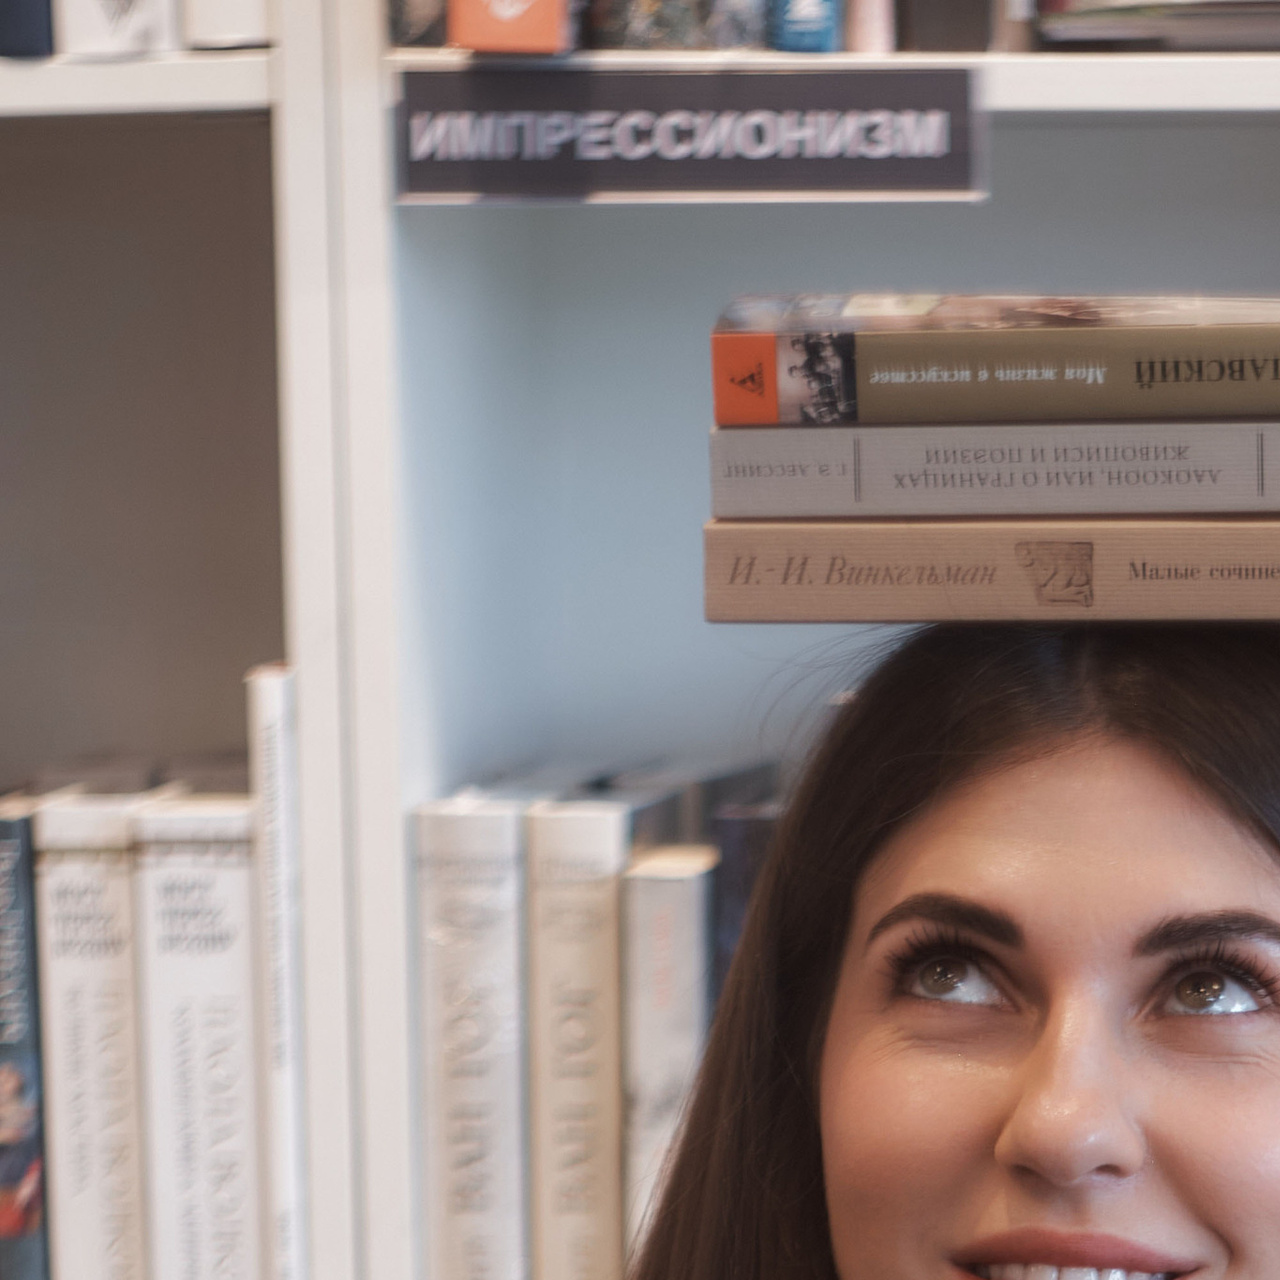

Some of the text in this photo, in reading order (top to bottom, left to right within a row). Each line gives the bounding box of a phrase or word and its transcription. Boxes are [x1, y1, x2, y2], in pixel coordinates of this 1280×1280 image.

[408, 109, 950, 161] ИМПРЕССИОНИЗМ
[869, 366, 1107, 385] Моя жизнь в искусстве
[924, 445, 1191, 465] ЖИВОПИСИ И ПОЭЗИИ
[723, 463, 811, 479] ЛЕССИНГ
[893, 469, 1222, 489] ЛАОКООН, ИЛИ О ГРАНИЦАХ
[823, 555, 998, 587] Винкельман
[1128, 560, 1201, 581] Малые
